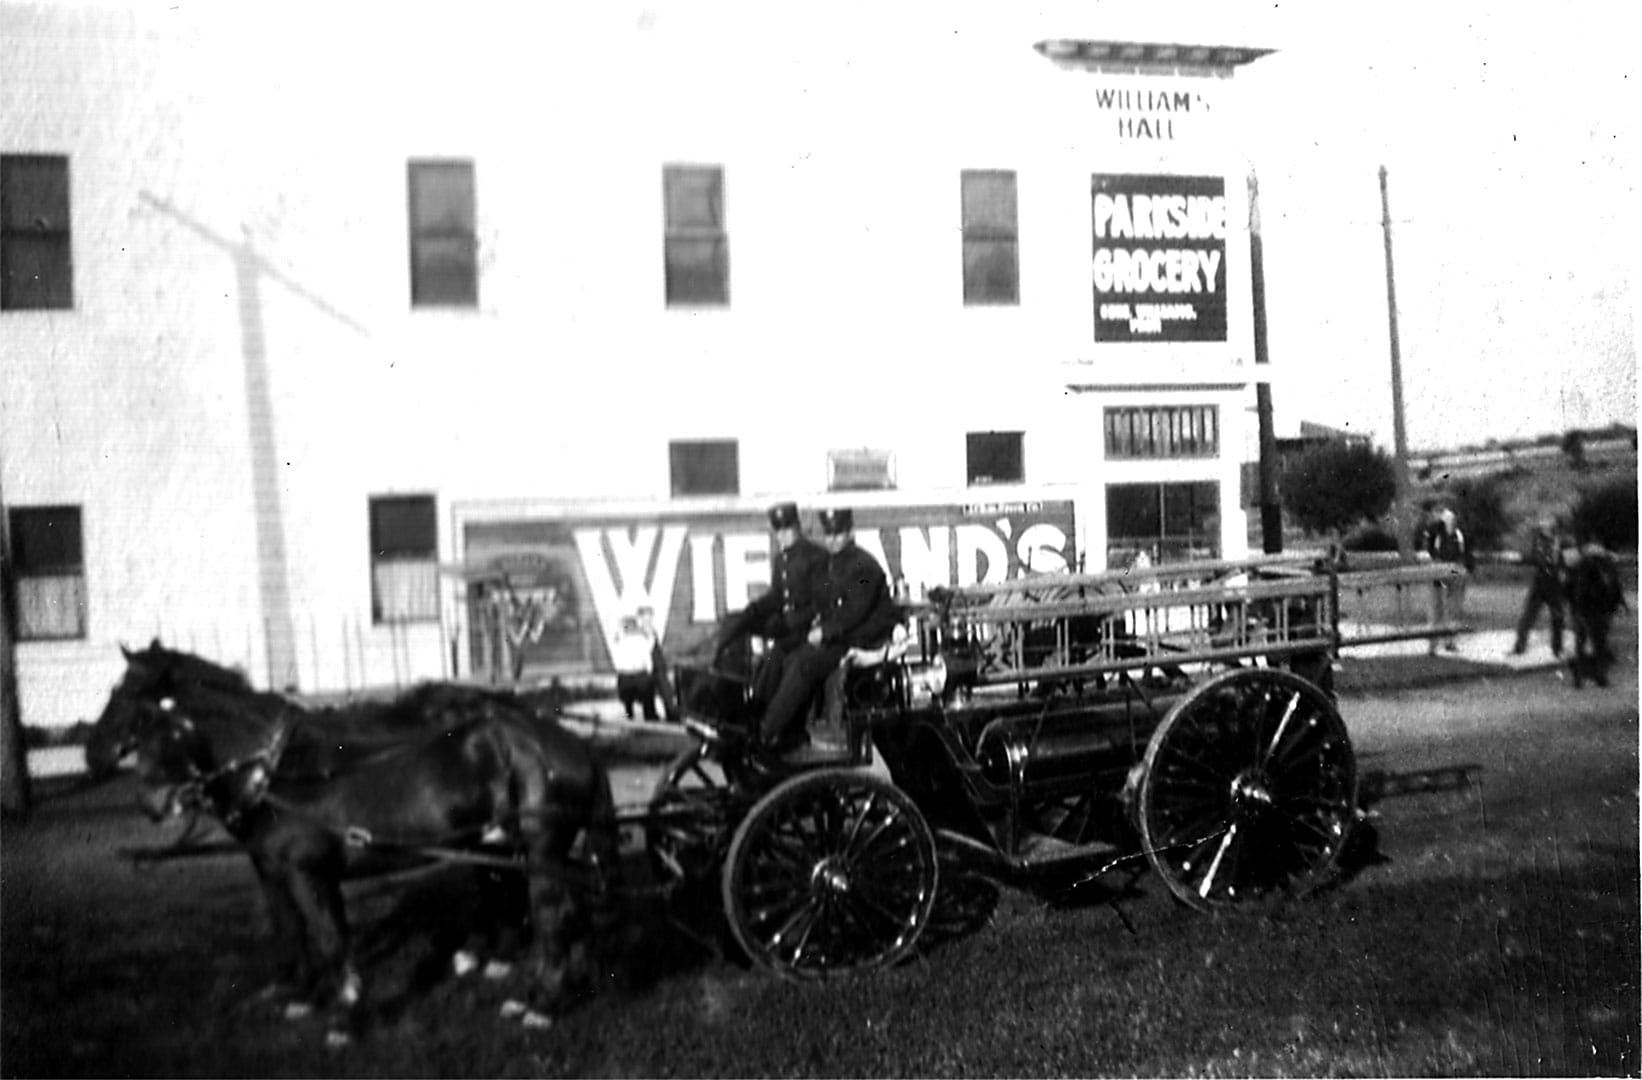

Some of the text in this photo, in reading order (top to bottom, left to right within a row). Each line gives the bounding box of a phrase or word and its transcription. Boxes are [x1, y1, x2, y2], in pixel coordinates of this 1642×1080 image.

[1118, 117, 1173, 140] HALL
[1094, 193, 1226, 240] PARKSIDE
[1093, 247, 1222, 294] GROCERY
[573, 518, 1067, 671] WIEND'S
